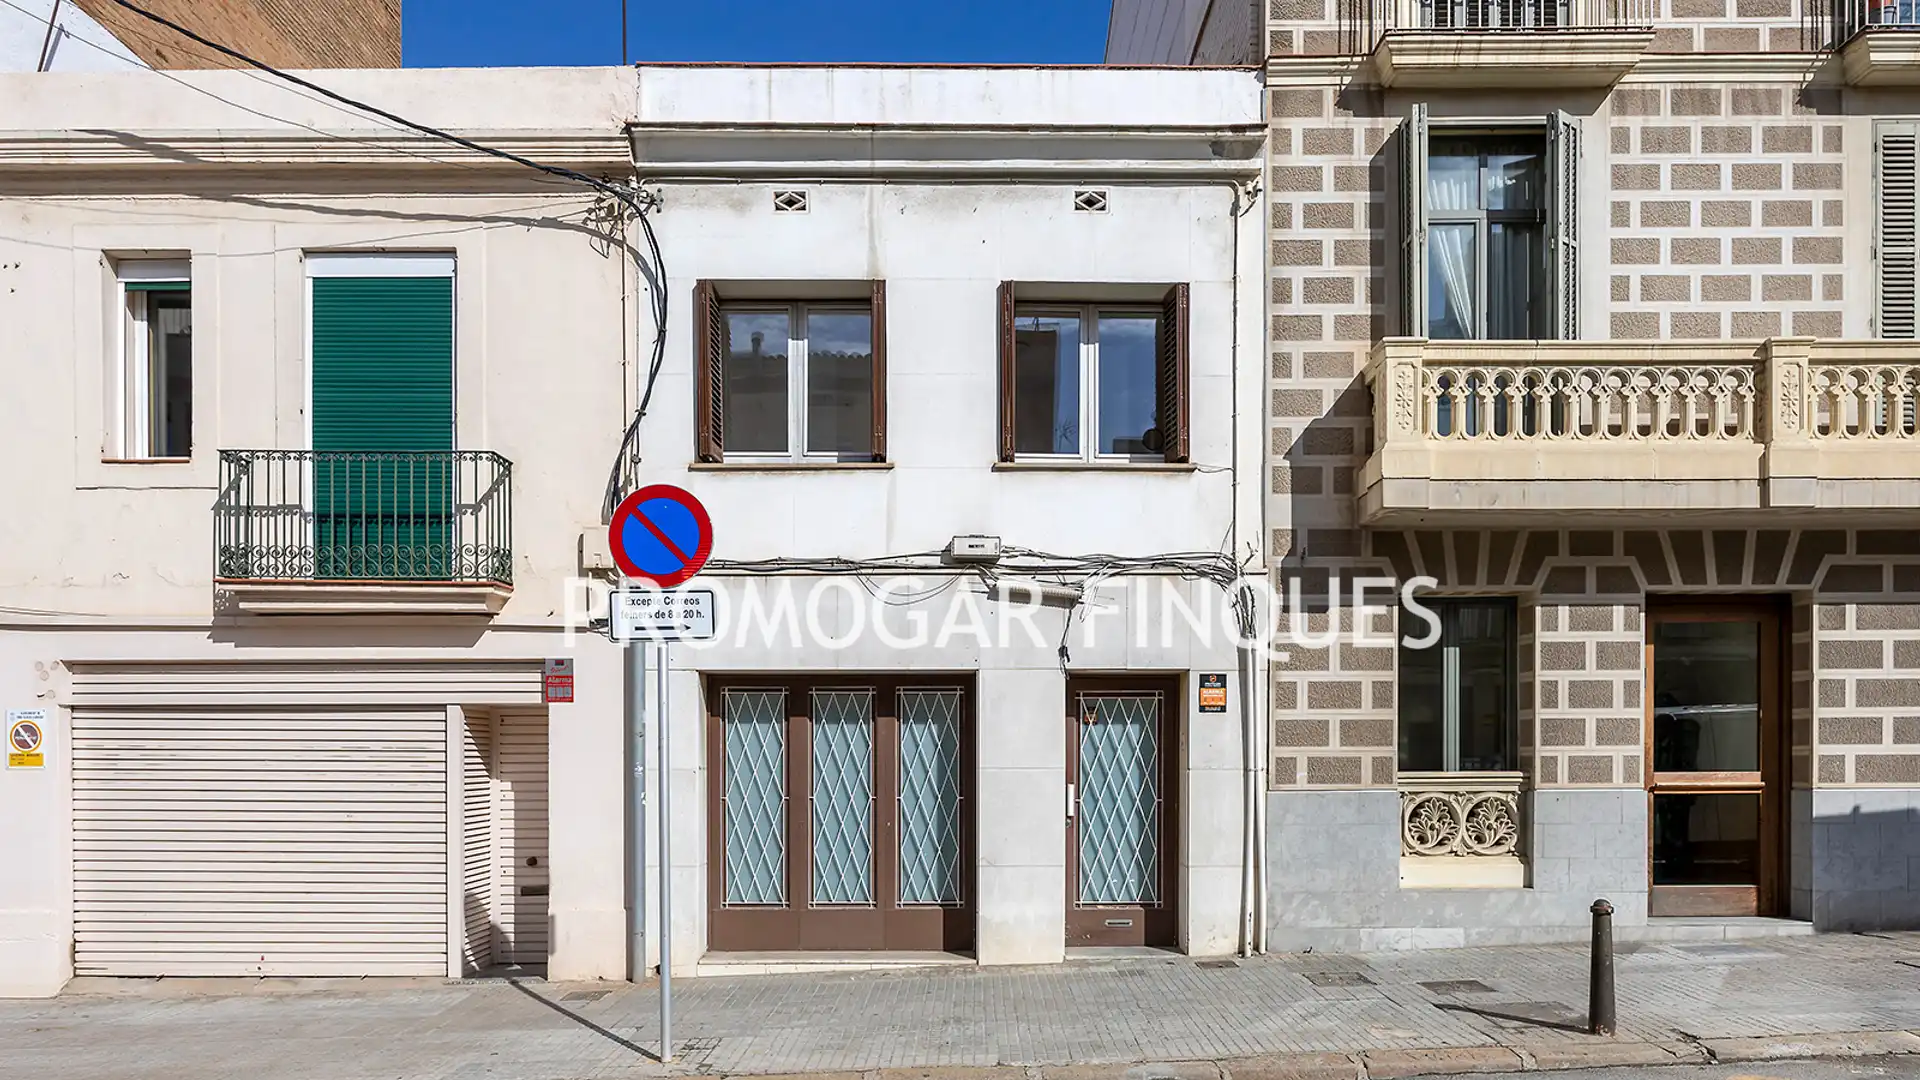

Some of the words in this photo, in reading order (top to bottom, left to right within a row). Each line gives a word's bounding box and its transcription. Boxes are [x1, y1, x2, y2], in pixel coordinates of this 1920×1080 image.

[663, 596, 700, 606] Correos
[654, 609, 666, 619] de
[668, 609, 673, 619] 8
[683, 609, 694, 619] 20
[696, 609, 705, 619] h.
